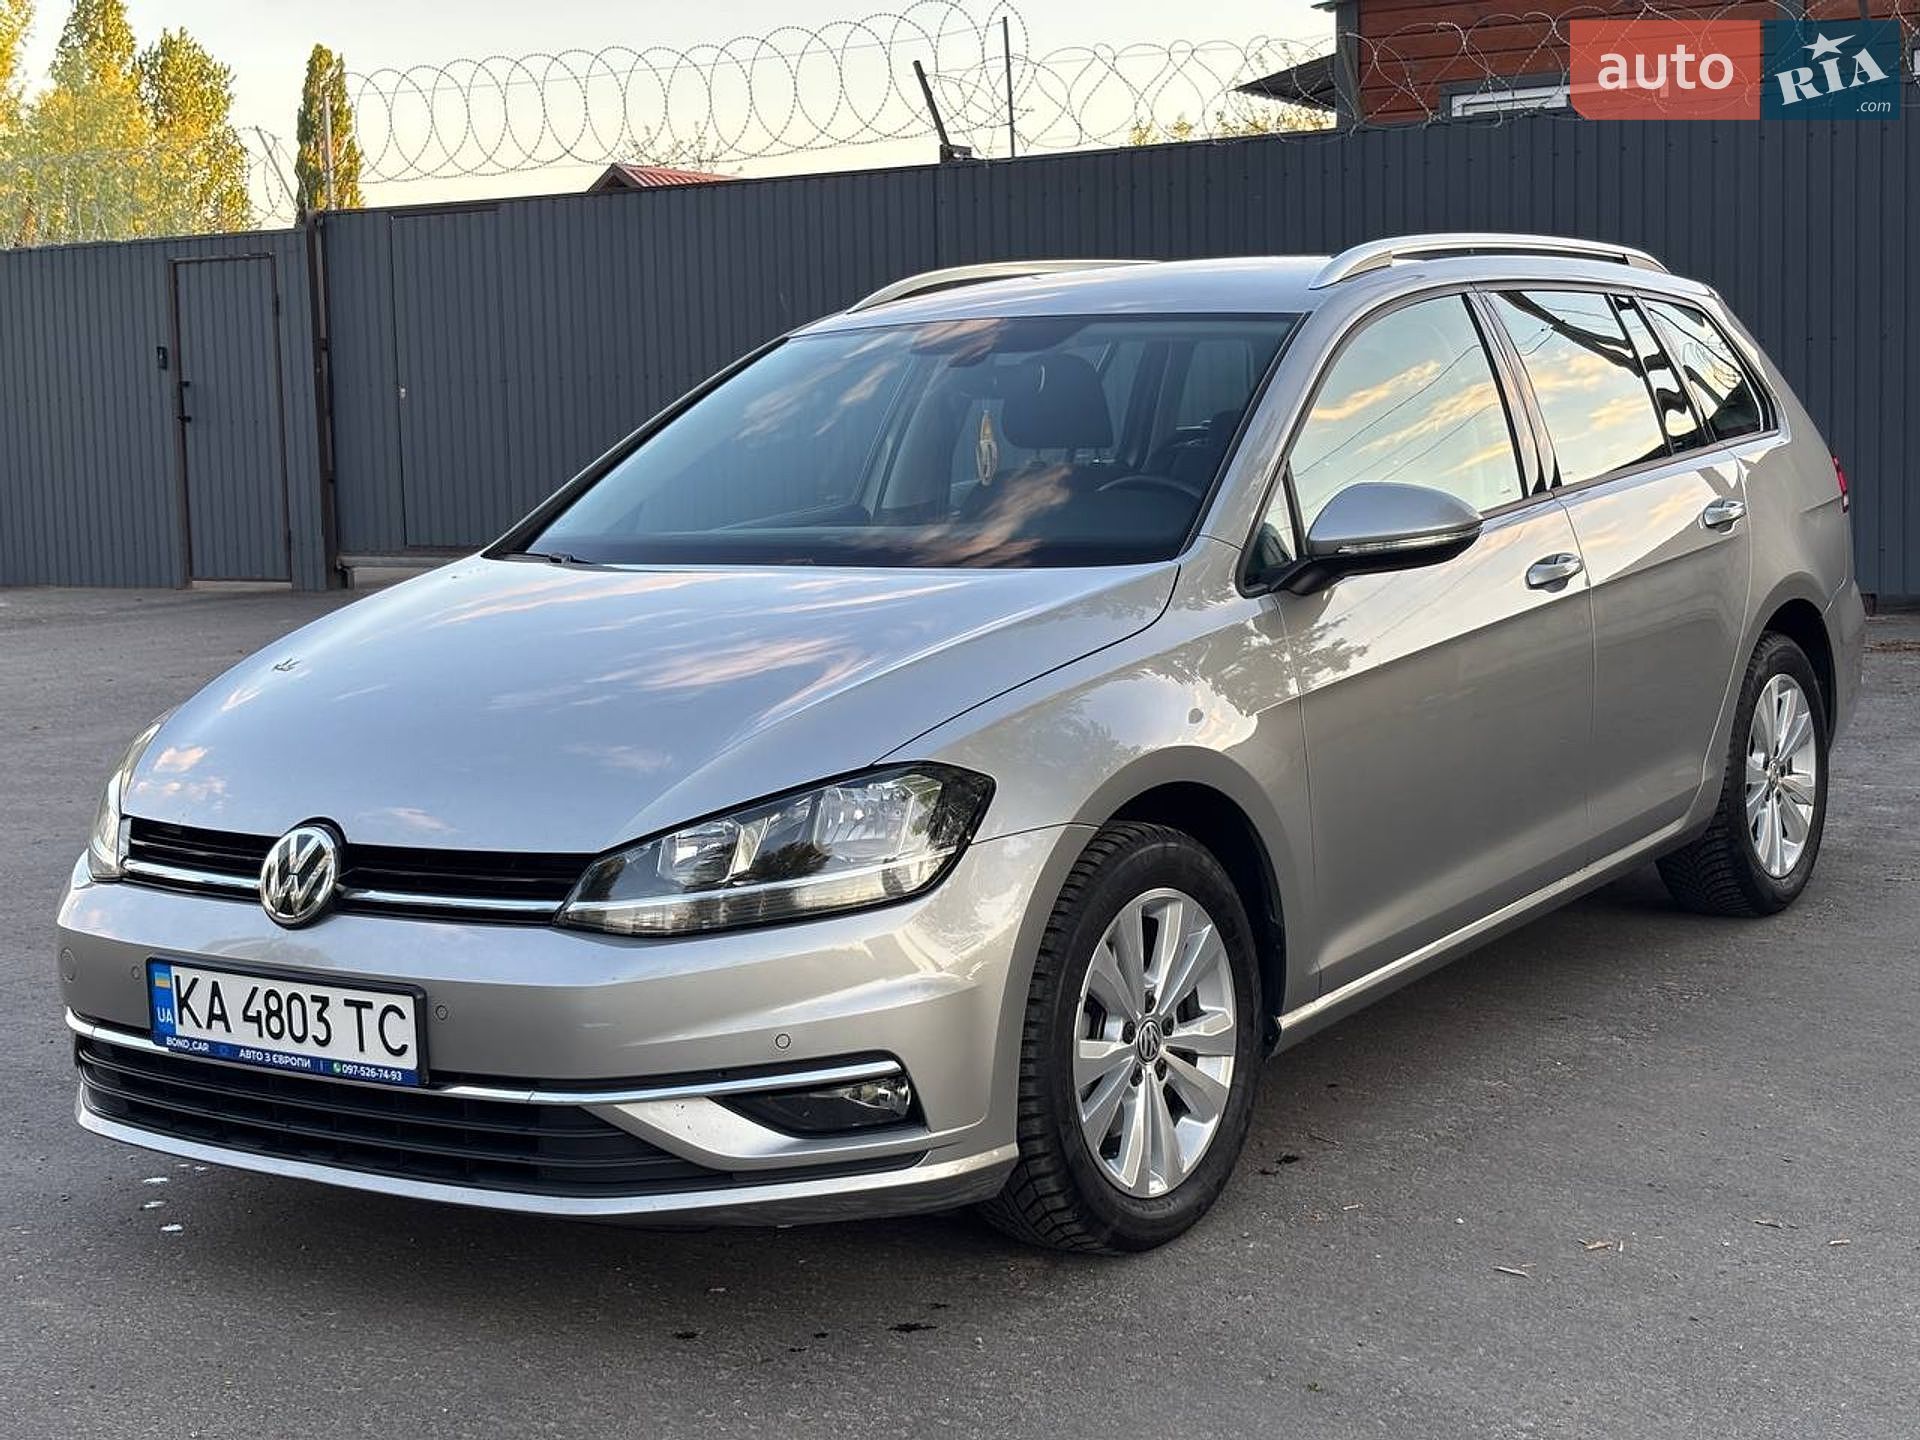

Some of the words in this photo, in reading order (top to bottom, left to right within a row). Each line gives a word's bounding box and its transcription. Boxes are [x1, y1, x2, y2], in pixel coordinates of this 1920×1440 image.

[157, 1006, 174, 1025] UA
[174, 974, 232, 1033] KA
[241, 986, 332, 1047] 4803
[343, 998, 408, 1057] TC
[239, 1049, 264, 1061] АВТО
[272, 1054, 311, 1069] ЄВРОПИ
[342, 1063, 403, 1082] 097-526-74-93
